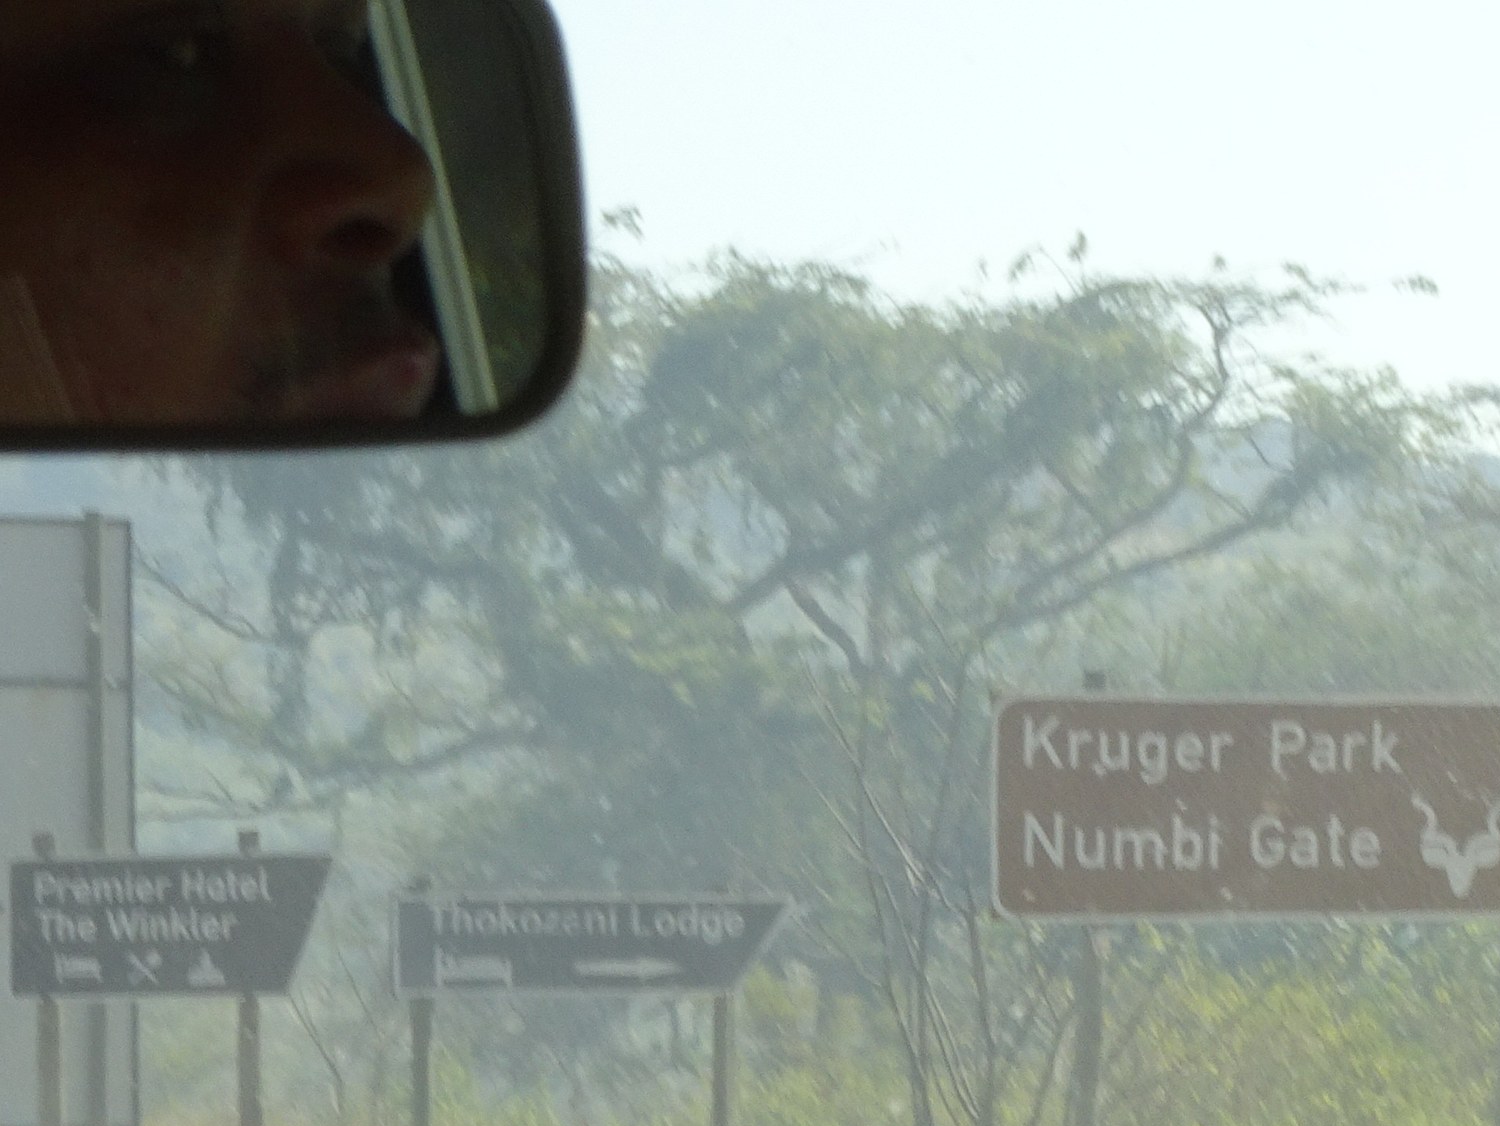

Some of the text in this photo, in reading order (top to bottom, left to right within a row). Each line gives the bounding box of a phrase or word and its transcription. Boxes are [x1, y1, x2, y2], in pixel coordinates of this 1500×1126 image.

[1023, 715, 1402, 784] Kruger Park
[1023, 812, 1382, 869] Numbi Gate
[34, 866, 272, 903] Premier Hotel
[36, 906, 237, 942] The Winkler
[631, 903, 746, 944] Lodge
